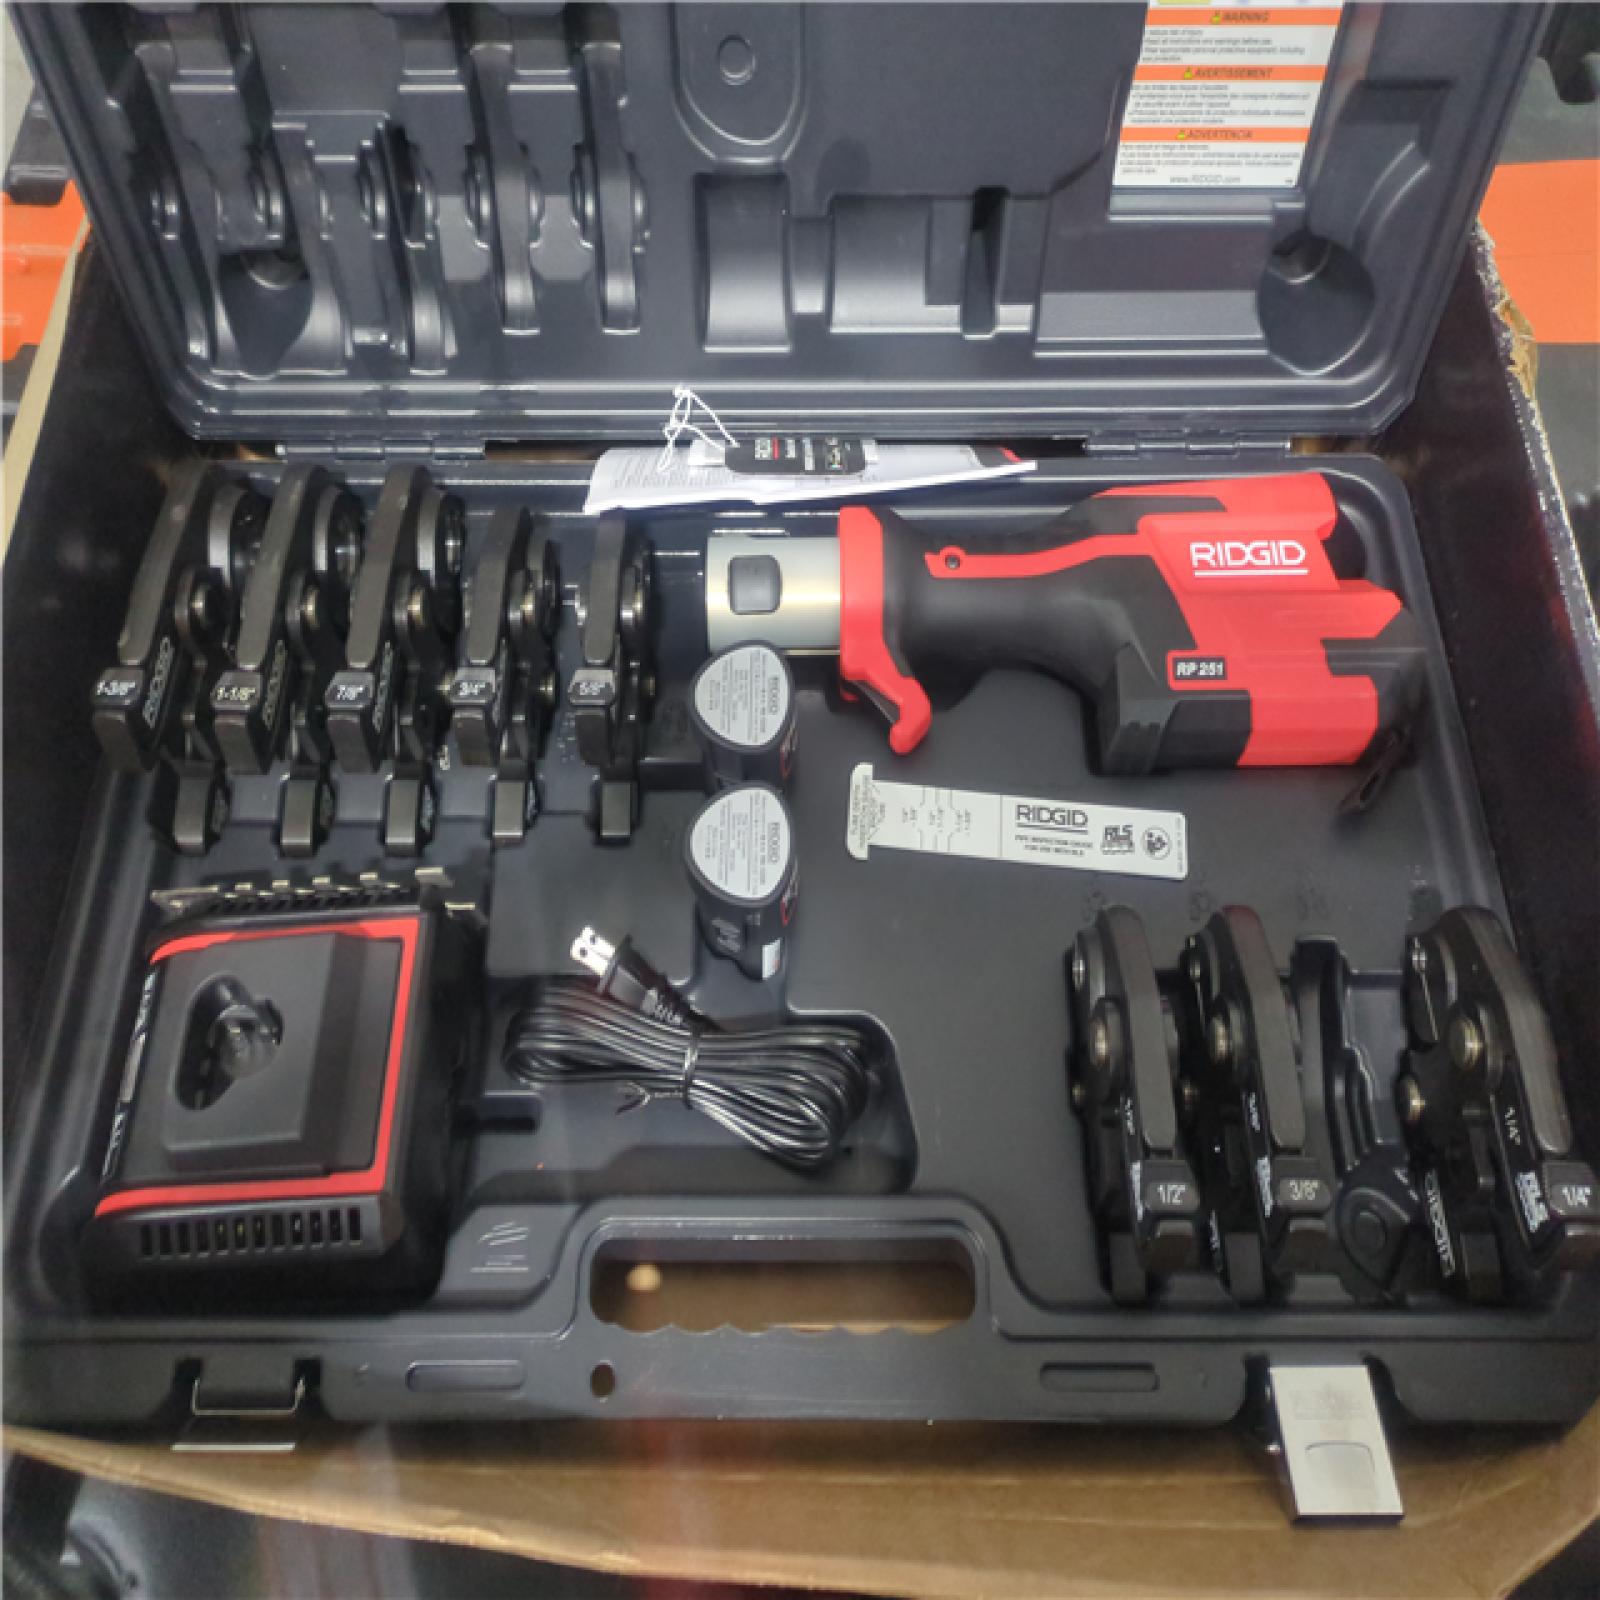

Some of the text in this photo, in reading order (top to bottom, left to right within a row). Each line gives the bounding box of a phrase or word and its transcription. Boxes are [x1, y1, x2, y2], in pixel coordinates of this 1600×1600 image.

[1223, 12, 1269, 21] WARNING
[1194, 67, 1273, 77] AVERTISSEMENT
[1187, 130, 1253, 139] ADVERTENCIA
[1169, 174, 1241, 183] www.RIDGID.com
[1189, 540, 1306, 568] RIDGID
[1176, 661, 1197, 676] RP
[217, 687, 256, 701] 1-1/8"
[1015, 804, 1088, 826] RIDGID
[1157, 1183, 1187, 1205] 1/2"
[1288, 1179, 1319, 1200] 3/8"
[1562, 1186, 1592, 1207] 1/4"
